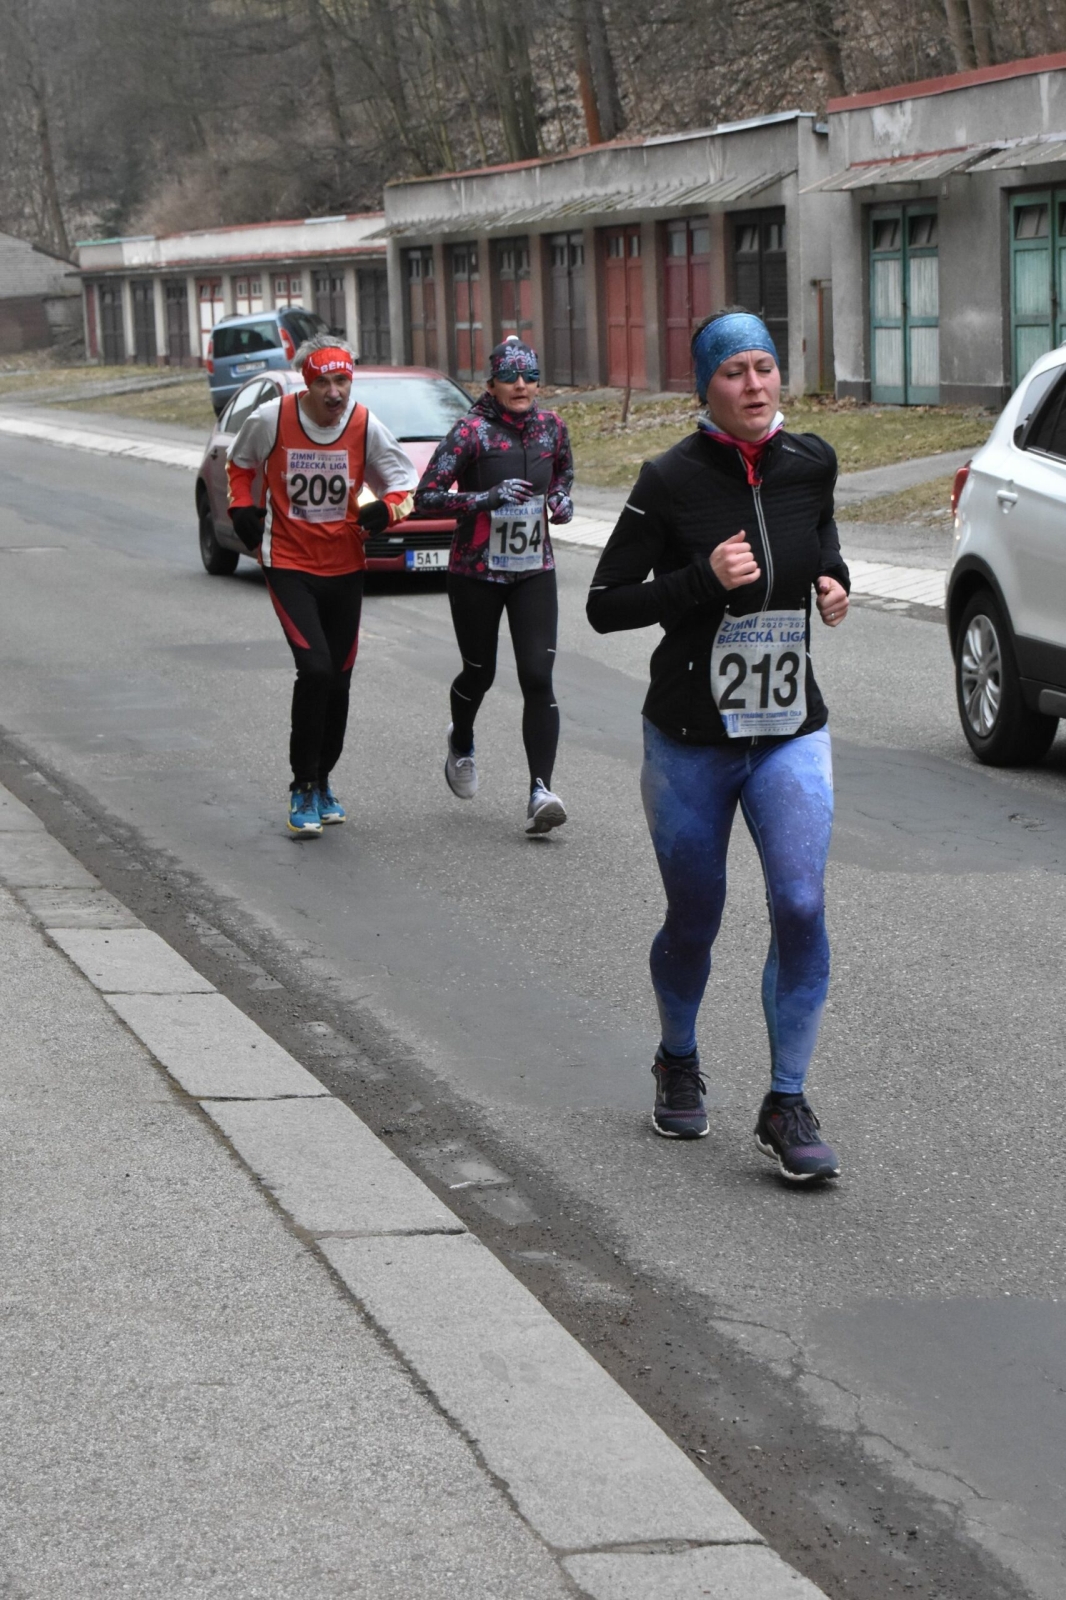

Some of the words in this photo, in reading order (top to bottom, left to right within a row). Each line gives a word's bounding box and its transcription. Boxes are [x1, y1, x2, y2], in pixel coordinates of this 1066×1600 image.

[291, 452, 316, 460] ZIMNÍ
[290, 473, 347, 506] 209
[495, 520, 542, 555] 154
[416, 552, 439, 565] 5A1
[721, 616, 759, 632] ZIMNÍ
[718, 651, 800, 710] 213
